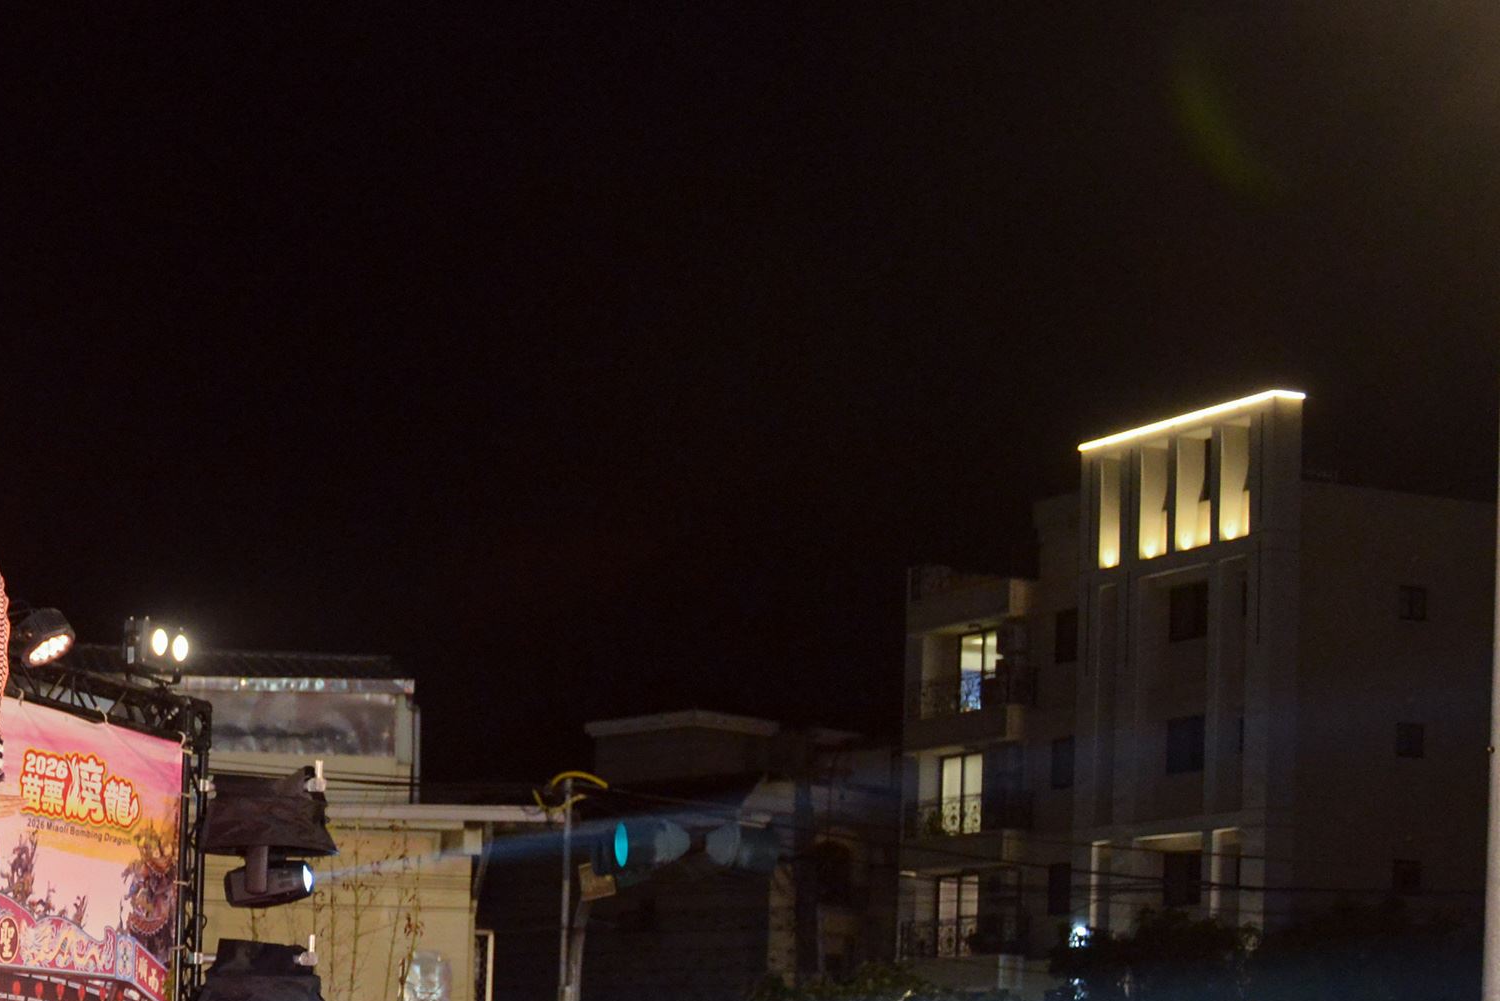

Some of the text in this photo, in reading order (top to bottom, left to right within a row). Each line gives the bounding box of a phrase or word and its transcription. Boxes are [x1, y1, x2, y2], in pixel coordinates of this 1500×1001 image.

[25, 753, 68, 779] 2026
[27, 818, 44, 830] 2026
[46, 821, 68, 834] Miaoli
